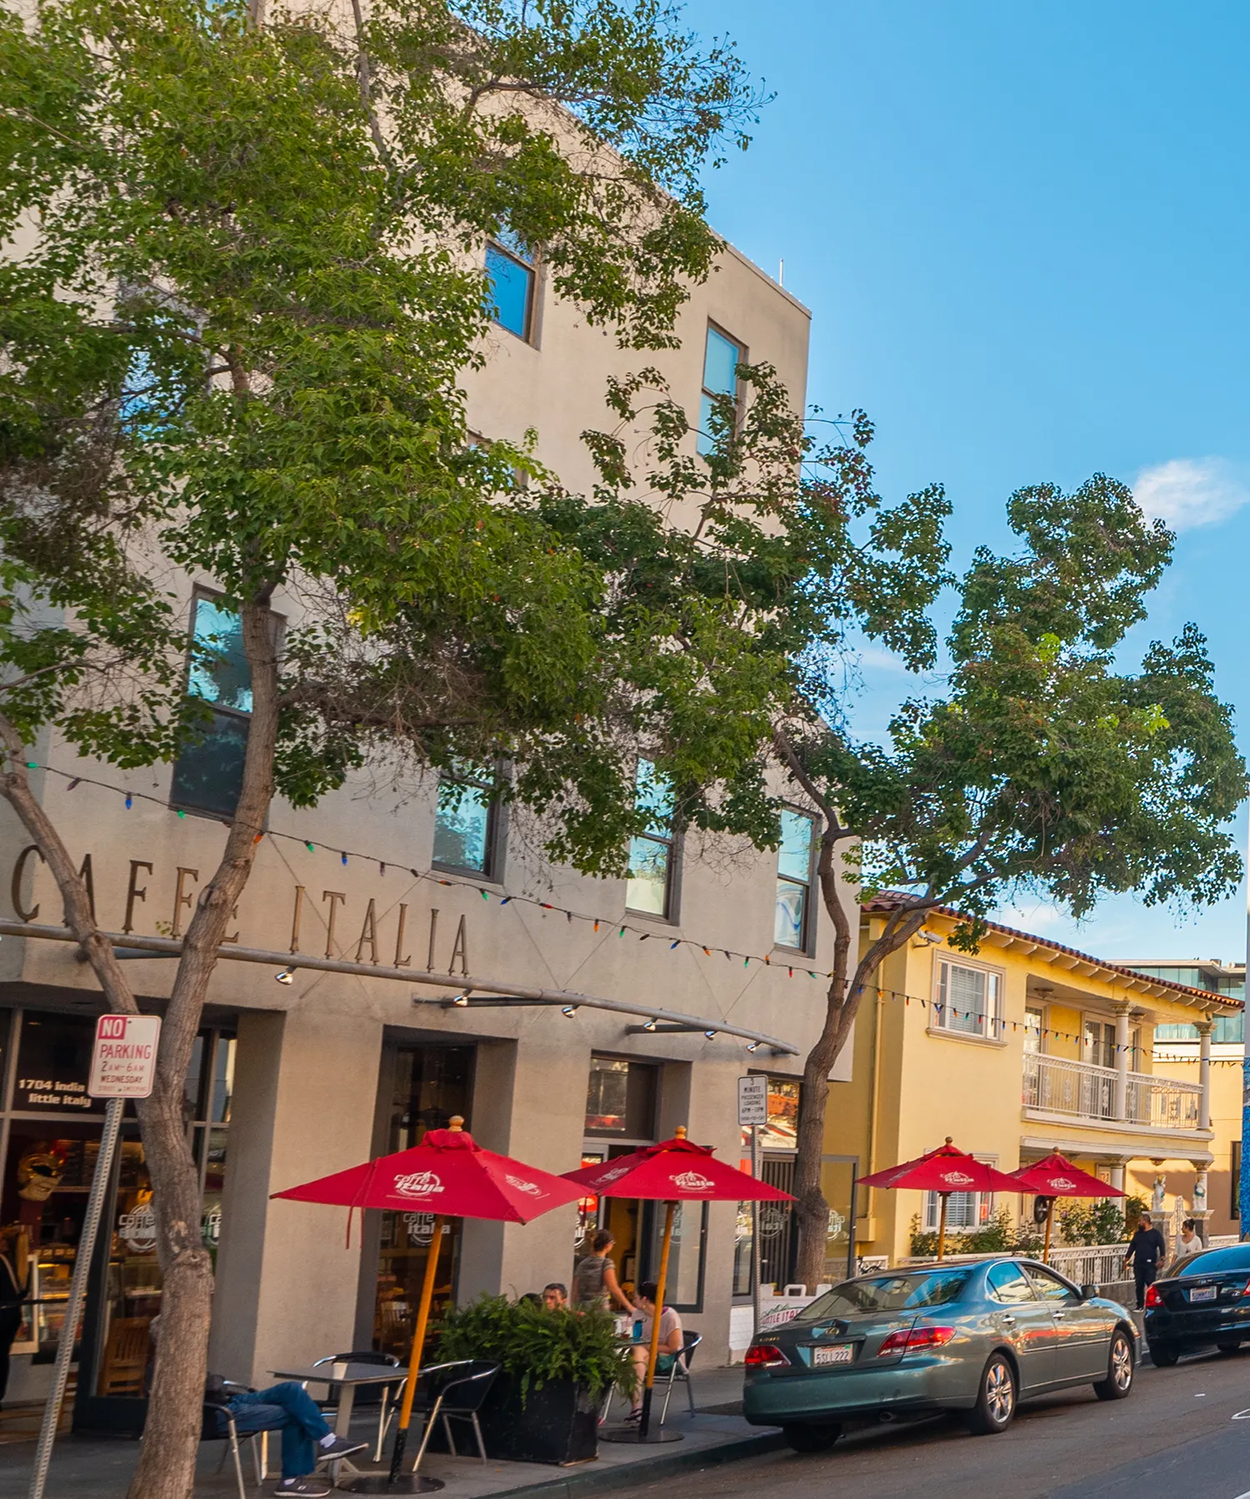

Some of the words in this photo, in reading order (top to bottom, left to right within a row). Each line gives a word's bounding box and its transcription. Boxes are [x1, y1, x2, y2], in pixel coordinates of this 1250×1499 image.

[289, 885, 470, 975] ITALIA
[101, 1018, 124, 1037] NO
[99, 1044, 152, 1060] PARKING
[18, 1079, 52, 1091] 1704
[55, 1080, 85, 1092] india
[100, 1075, 144, 1084] WEDNESDAY
[28, 1093, 61, 1105] little
[62, 1094, 92, 1108] italy
[403, 1212, 434, 1223] caffe
[407, 1222, 451, 1235] itala
